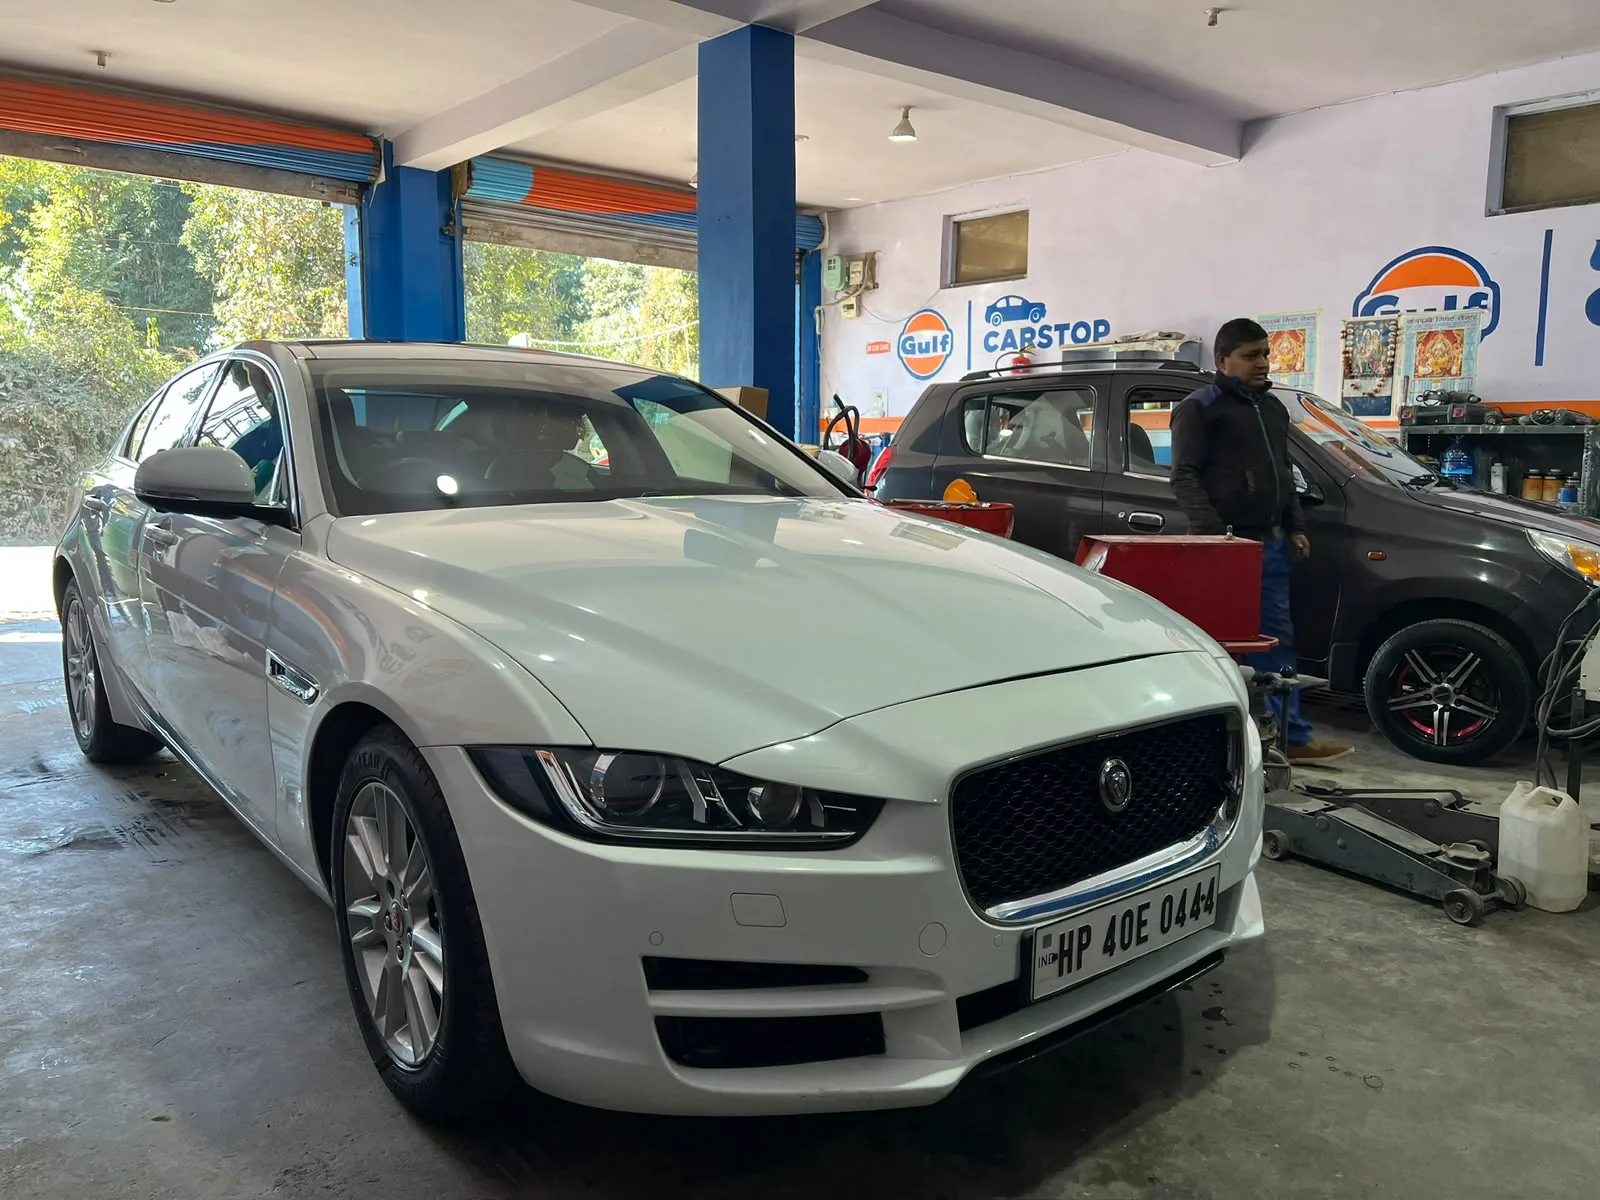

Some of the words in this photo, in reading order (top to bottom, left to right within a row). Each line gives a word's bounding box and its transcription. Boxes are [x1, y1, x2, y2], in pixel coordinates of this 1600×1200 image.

[1360, 291, 1488, 316] Gf
[901, 334, 949, 355] Gulf
[984, 318, 1111, 354] CARSTOP
[1058, 924, 1092, 978] HP
[1103, 901, 1152, 957] 40E
[1160, 877, 1216, 934] 0444
[1038, 952, 1054, 969] IND
